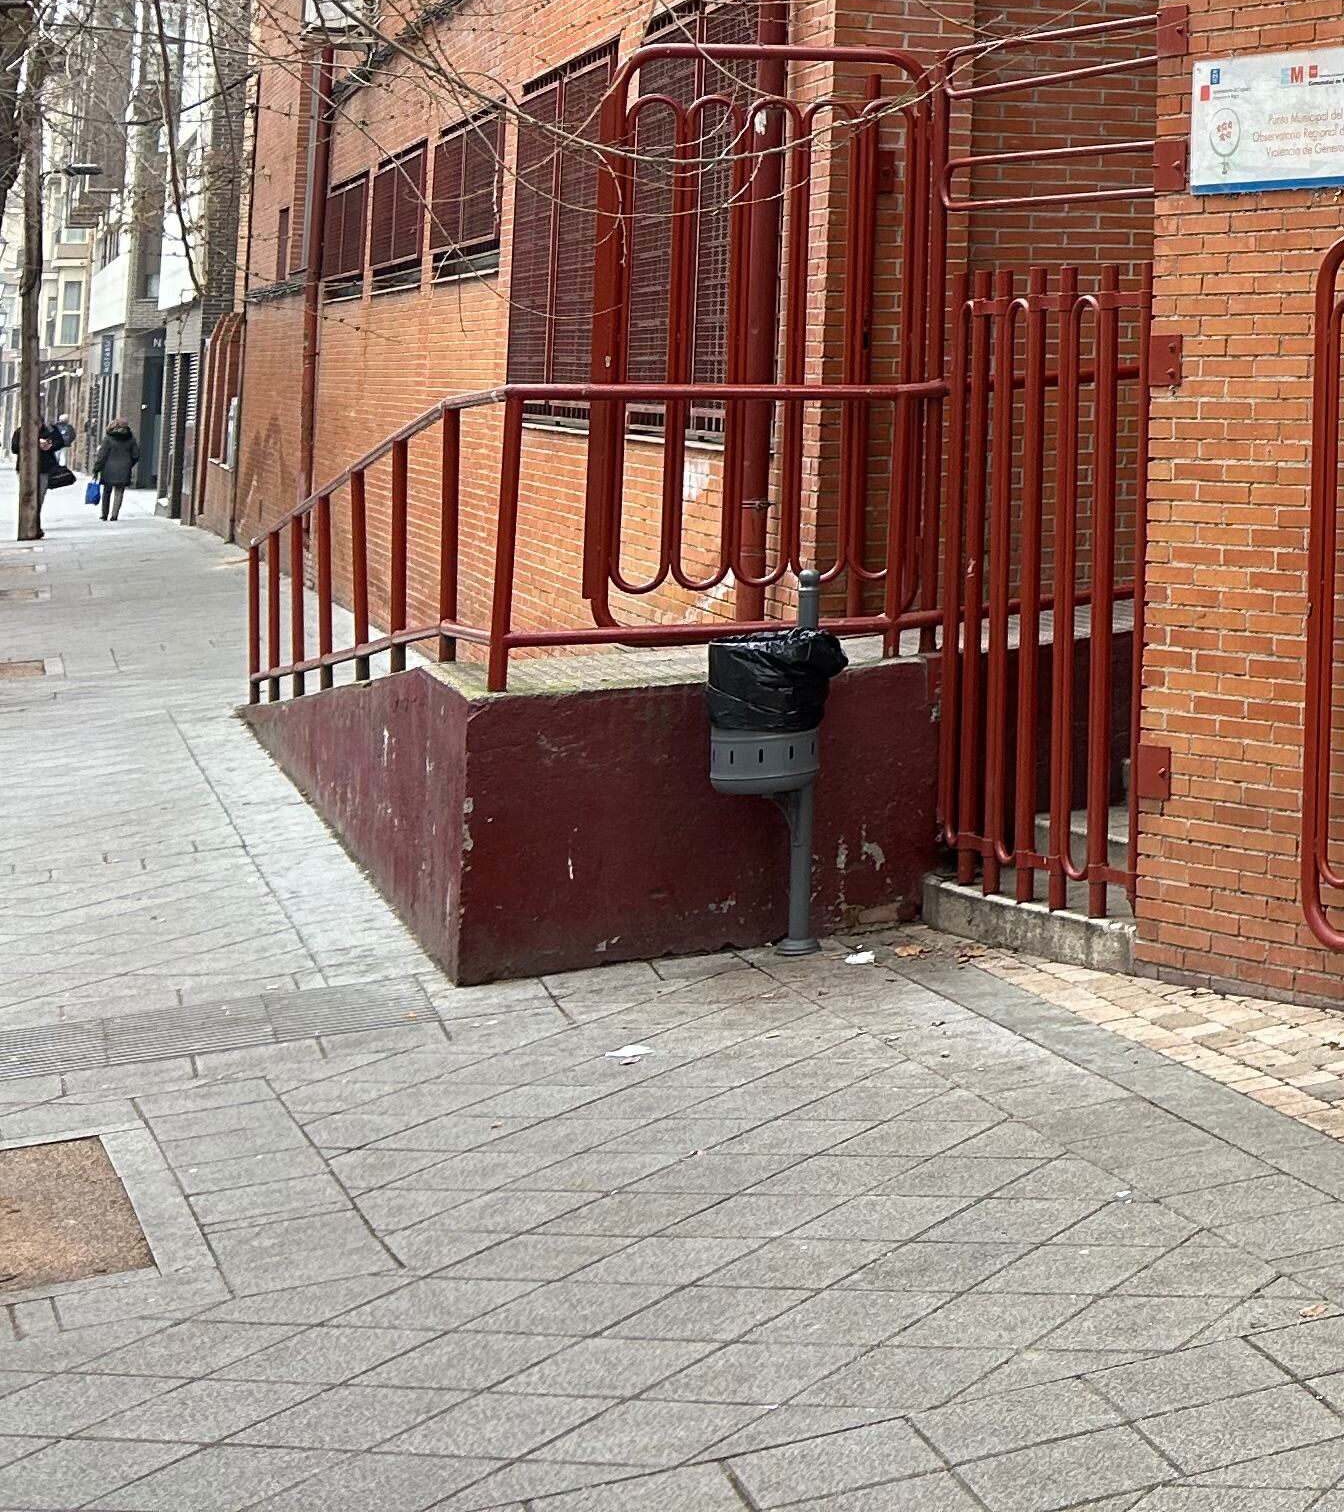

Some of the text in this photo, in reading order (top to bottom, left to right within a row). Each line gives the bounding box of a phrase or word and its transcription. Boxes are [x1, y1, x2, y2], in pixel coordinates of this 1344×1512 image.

[1290, 110, 1330, 126] Municipal
[1330, 107, 1344, 120] del
[1303, 123, 1339, 142] Regional
[1266, 144, 1300, 159] Violencia
[1302, 143, 1313, 155] de
